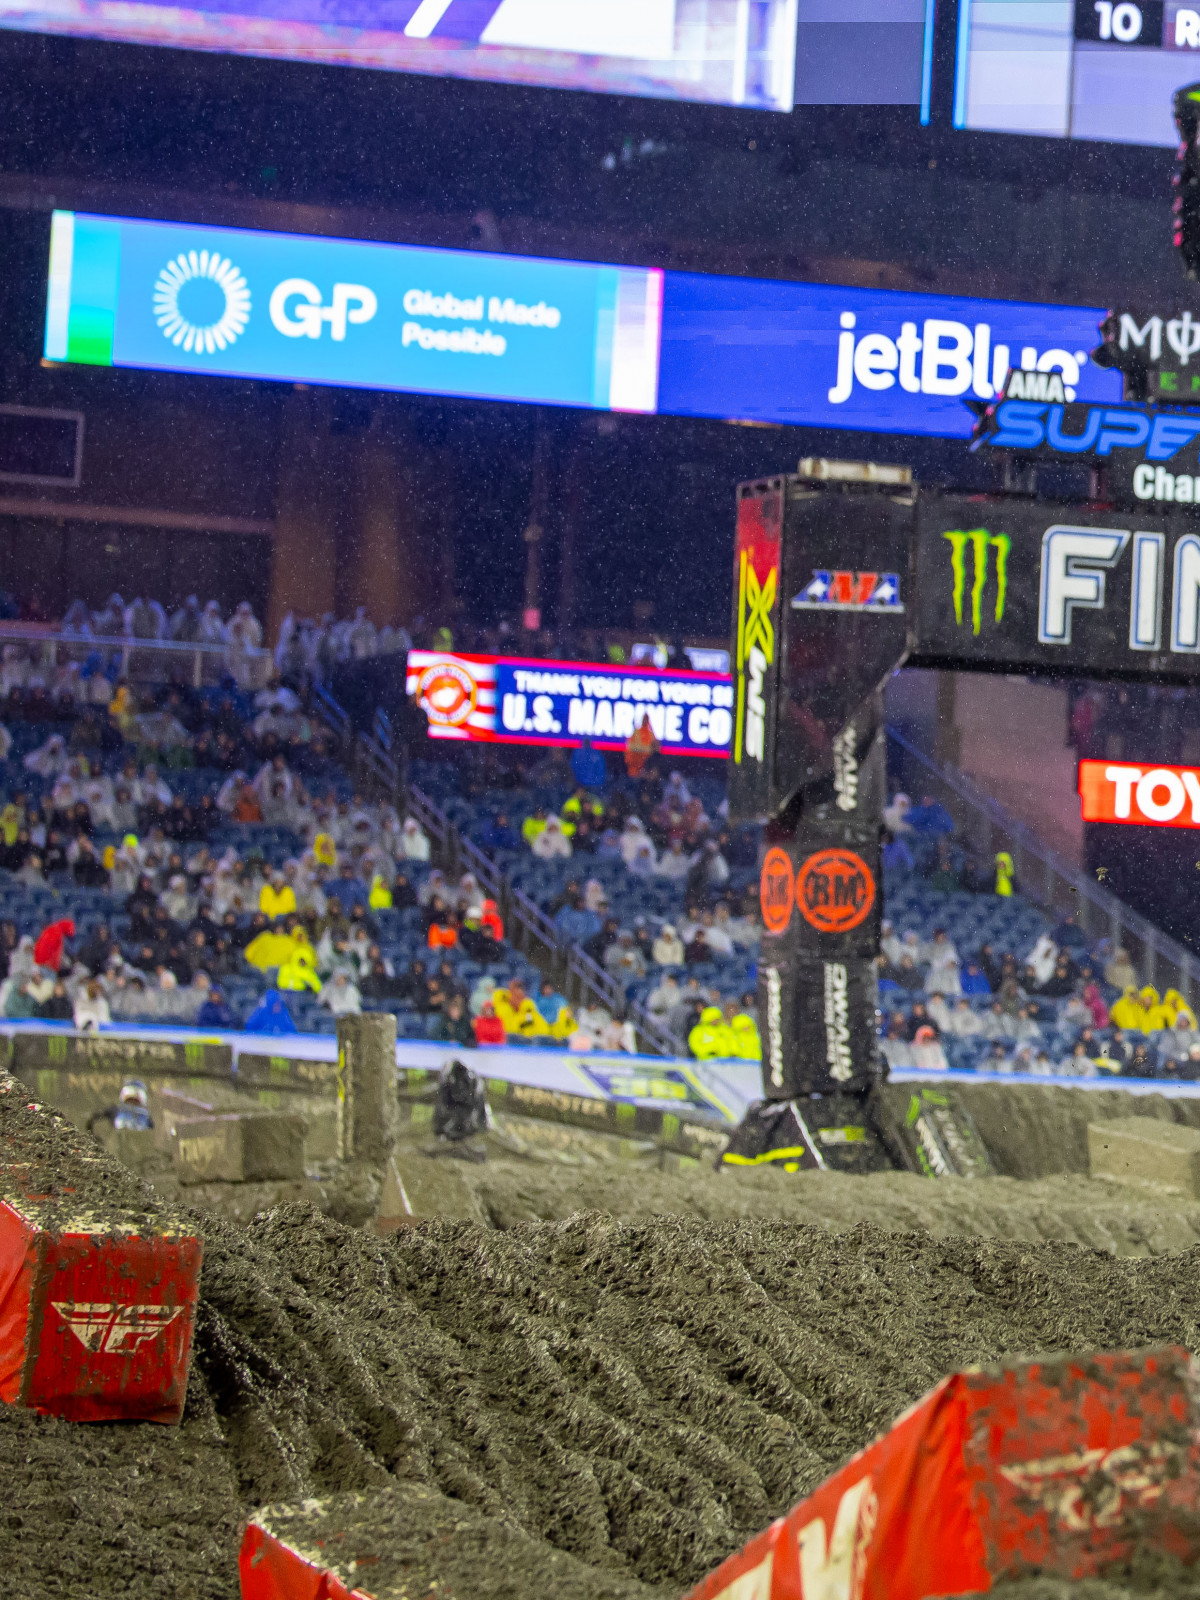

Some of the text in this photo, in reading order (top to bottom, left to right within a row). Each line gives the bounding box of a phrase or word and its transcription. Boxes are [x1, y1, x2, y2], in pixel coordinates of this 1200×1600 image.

[1094, 2, 1143, 42] 10
[403, 288, 561, 328] Global Made
[402, 321, 507, 356] Possible
[1006, 371, 1066, 403] AMA
[514, 671, 580, 695] THANK
[582, 676, 621, 698] YOU
[623, 679, 659, 701] FOR
[660, 681, 711, 704] YOUR
[503, 694, 561, 733] U.S.
